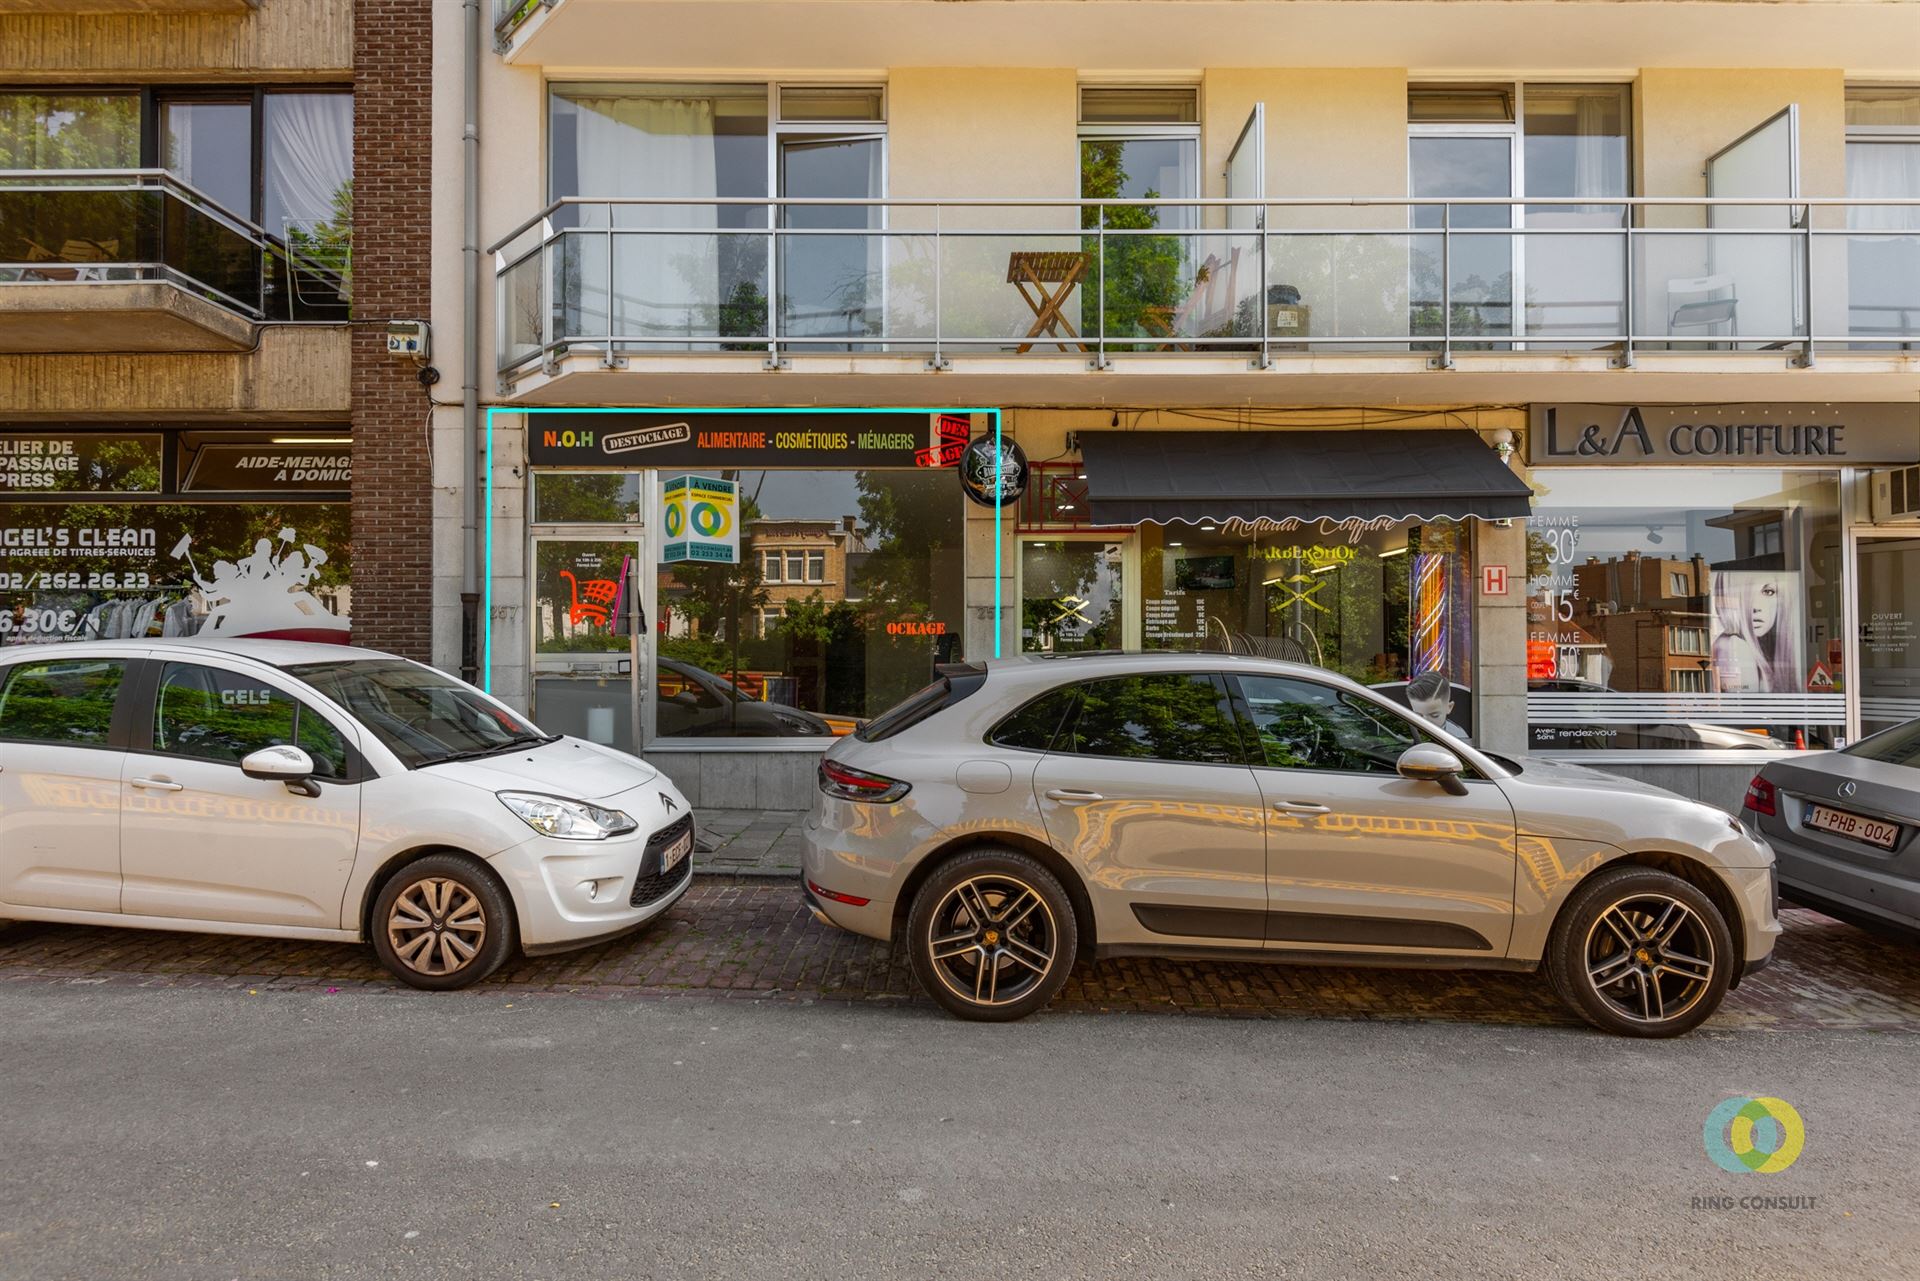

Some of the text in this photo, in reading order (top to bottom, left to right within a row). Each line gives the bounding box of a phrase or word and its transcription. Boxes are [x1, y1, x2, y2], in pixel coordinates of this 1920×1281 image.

[941, 420, 969, 437] DES
[1546, 406, 1847, 456] L&A COIFFURE
[543, 430, 594, 448] N.O.H
[609, 427, 684, 449] DESTOCKAGE
[697, 432, 766, 449] ALIMENTAIRE
[775, 429, 848, 450] COSMÉTIQUES
[858, 430, 915, 450] MÉNAGERS
[0, 440, 73, 454] LIER DE
[235, 456, 353, 468] AIDE-MENAG
[273, 469, 287, 481] A
[702, 483, 732, 492] VENDRE
[1529, 516, 1579, 527] FEMME
[0, 527, 156, 547] GEL'S CLEAN
[53, 549, 67, 557] DE
[70, 549, 156, 557] TITRES-SERVICES
[1487, 569, 1503, 591] H
[1530, 574, 1580, 586] HOMME
[886, 622, 946, 635] OCKAGE
[1530, 631, 1580, 643] FEMME
[222, 690, 271, 705] GELS
[1559, 729, 1617, 737] rendez-vous
